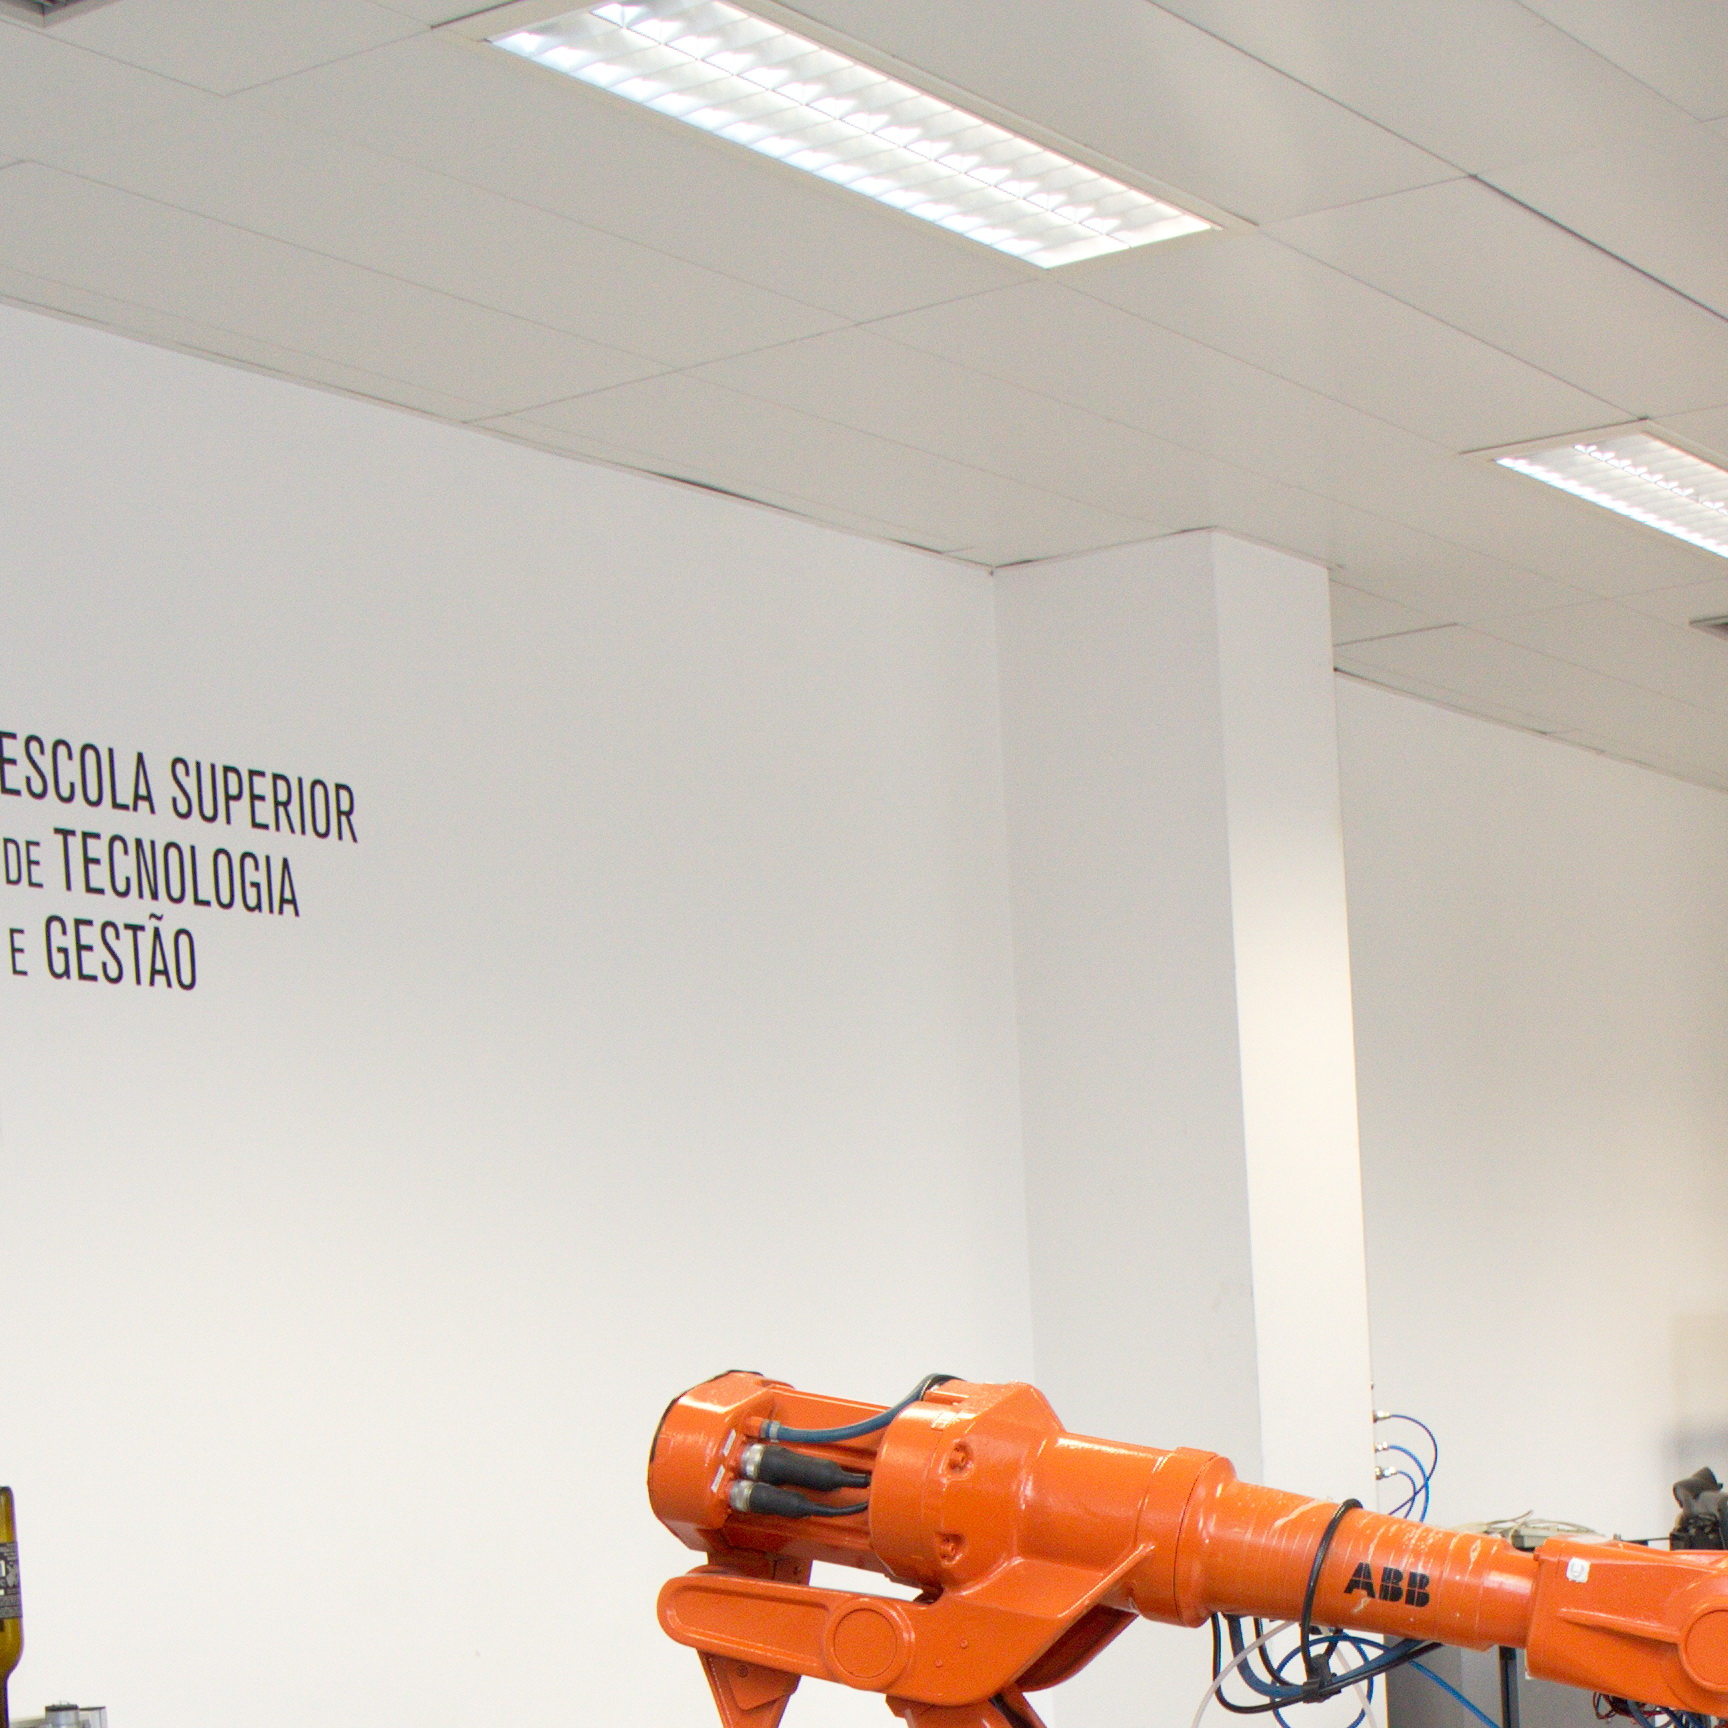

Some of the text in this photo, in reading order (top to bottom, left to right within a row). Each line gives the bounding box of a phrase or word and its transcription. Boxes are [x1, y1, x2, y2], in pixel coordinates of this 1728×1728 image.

[169, 757, 360, 846] SUPERIOR
[2, 829, 301, 920] DE TECNOLOGIA
[10, 906, 200, 994] E GESTÃO
[1343, 1561, 1431, 1608] ABB
